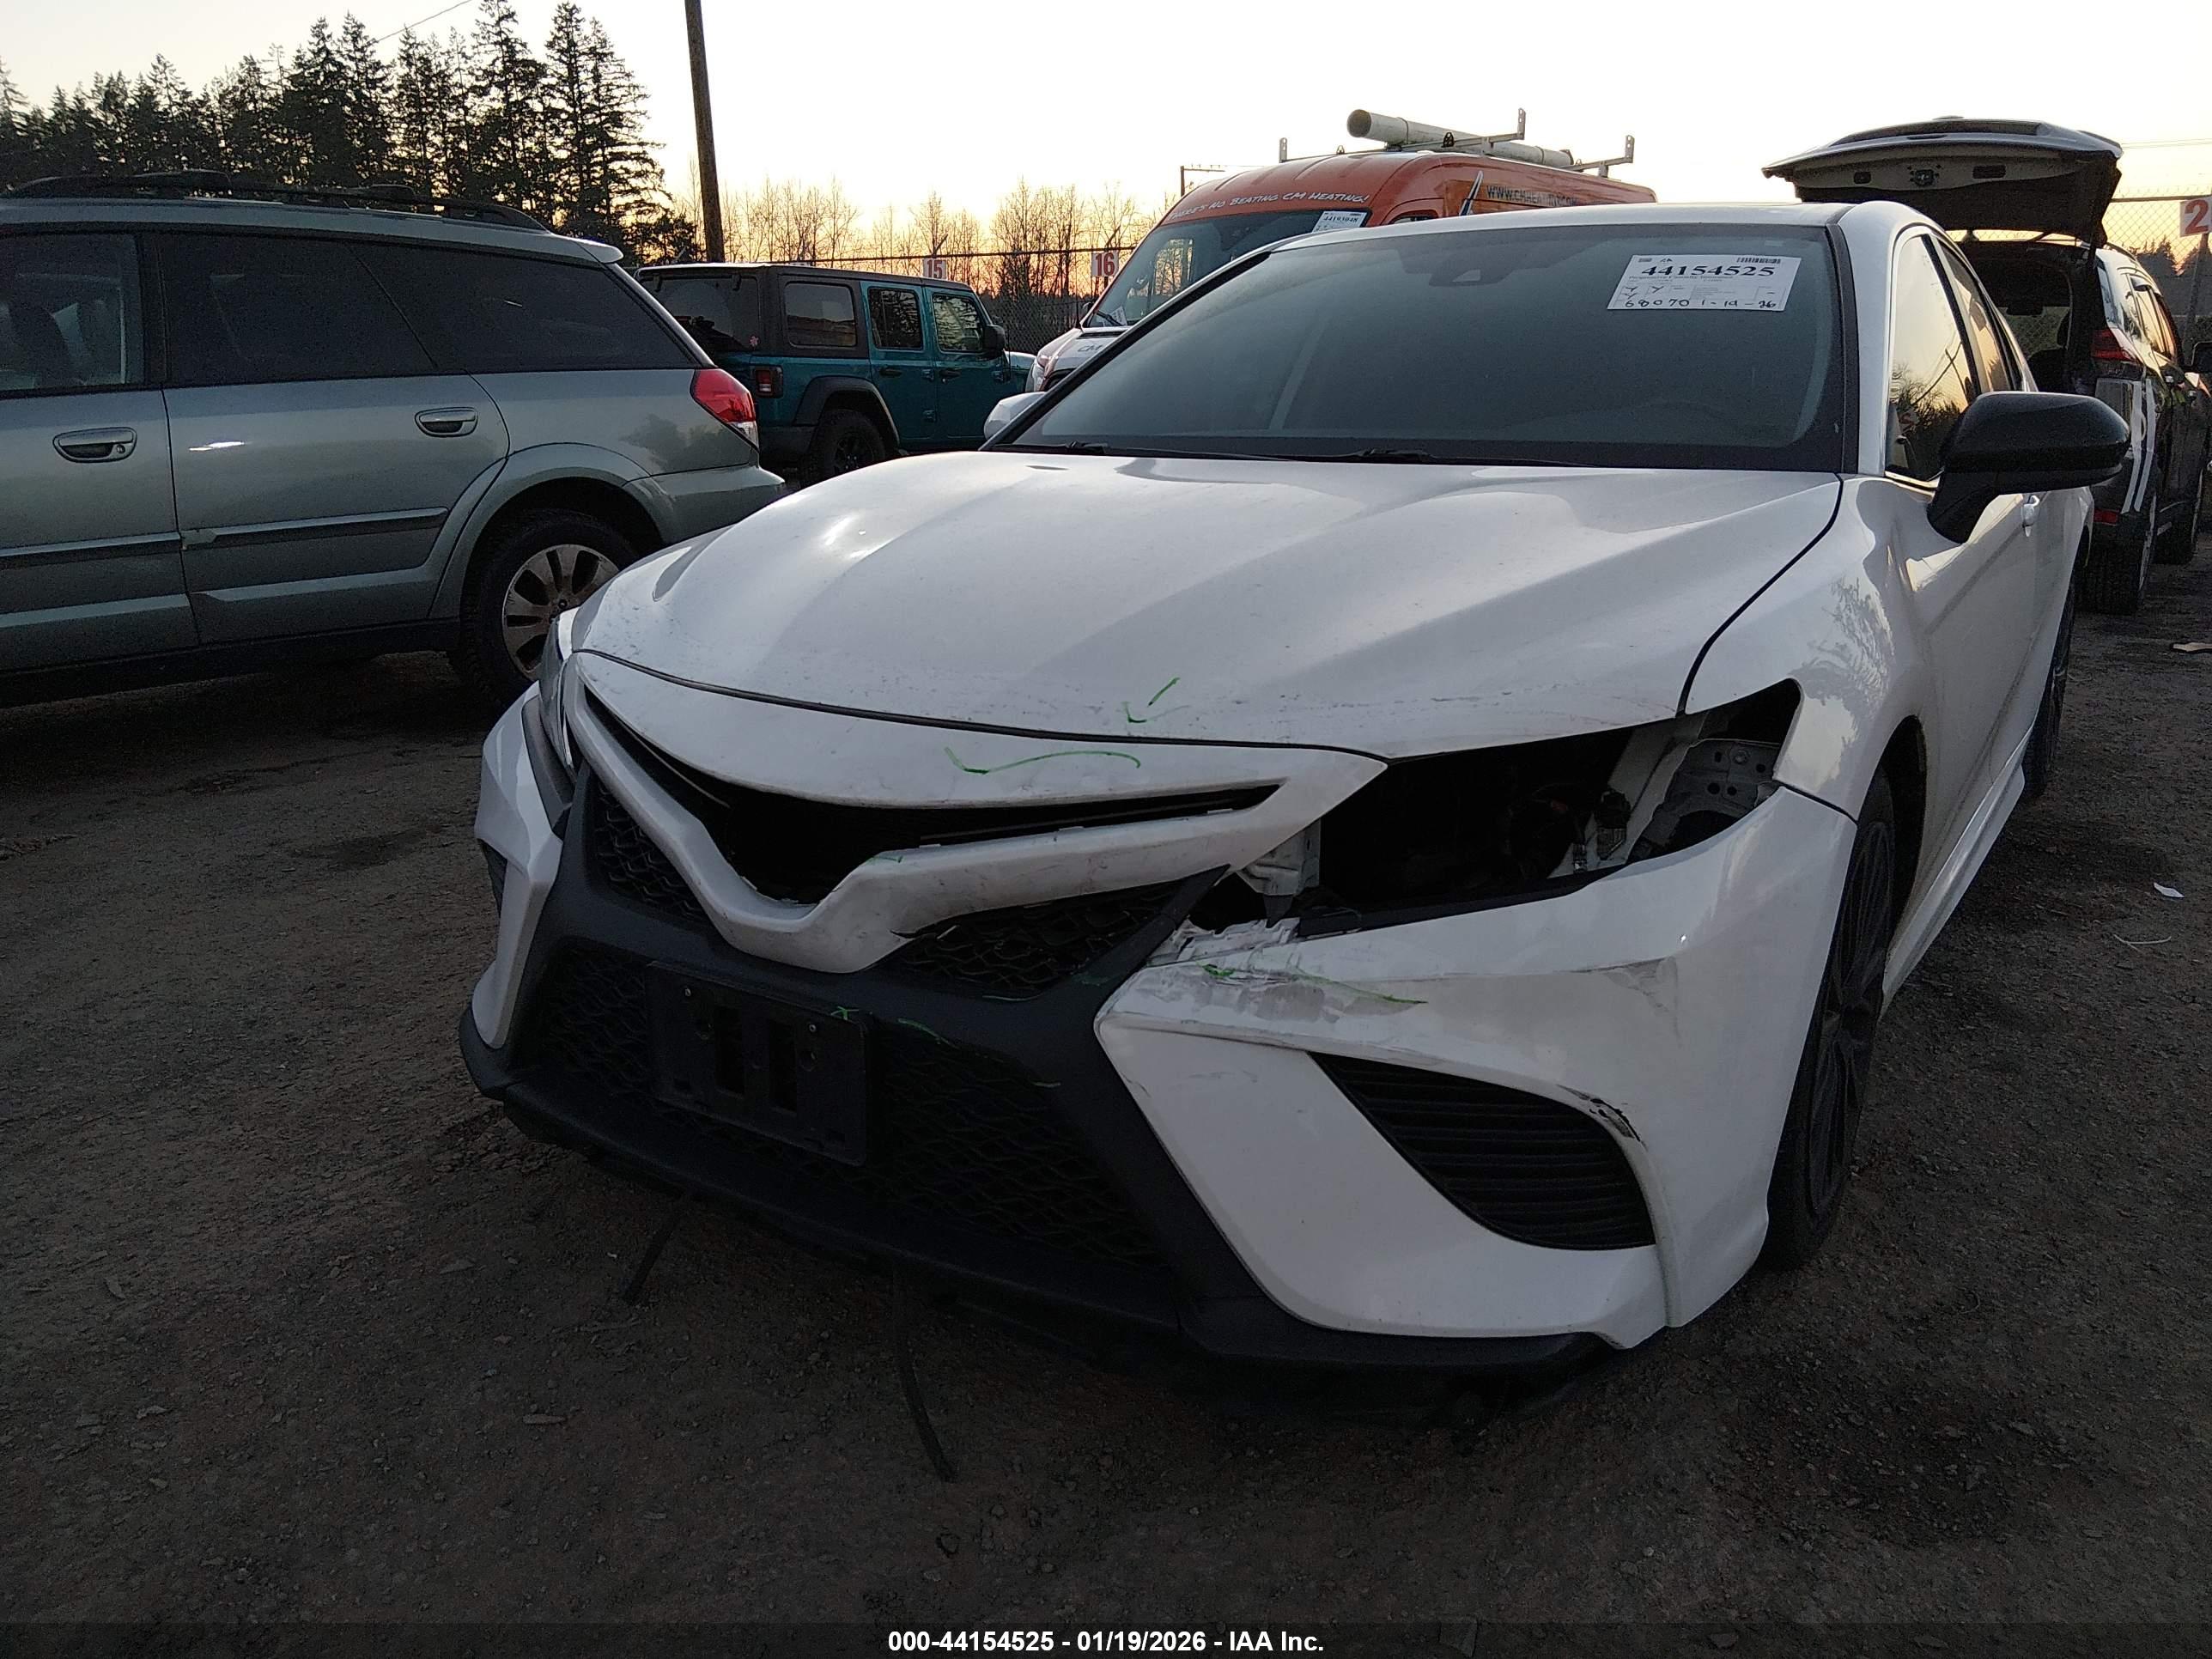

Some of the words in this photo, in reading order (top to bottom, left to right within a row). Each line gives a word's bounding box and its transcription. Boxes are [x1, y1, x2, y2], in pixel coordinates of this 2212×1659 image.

[1208, 201, 1226, 210] NO
[1229, 194, 1279, 206] BEATING
[1282, 191, 1307, 200] CM
[1307, 191, 1370, 204] HEATING!
[927, 259, 943, 279] 15
[1095, 252, 1115, 276] 16
[1641, 265, 1776, 276] 44154525
